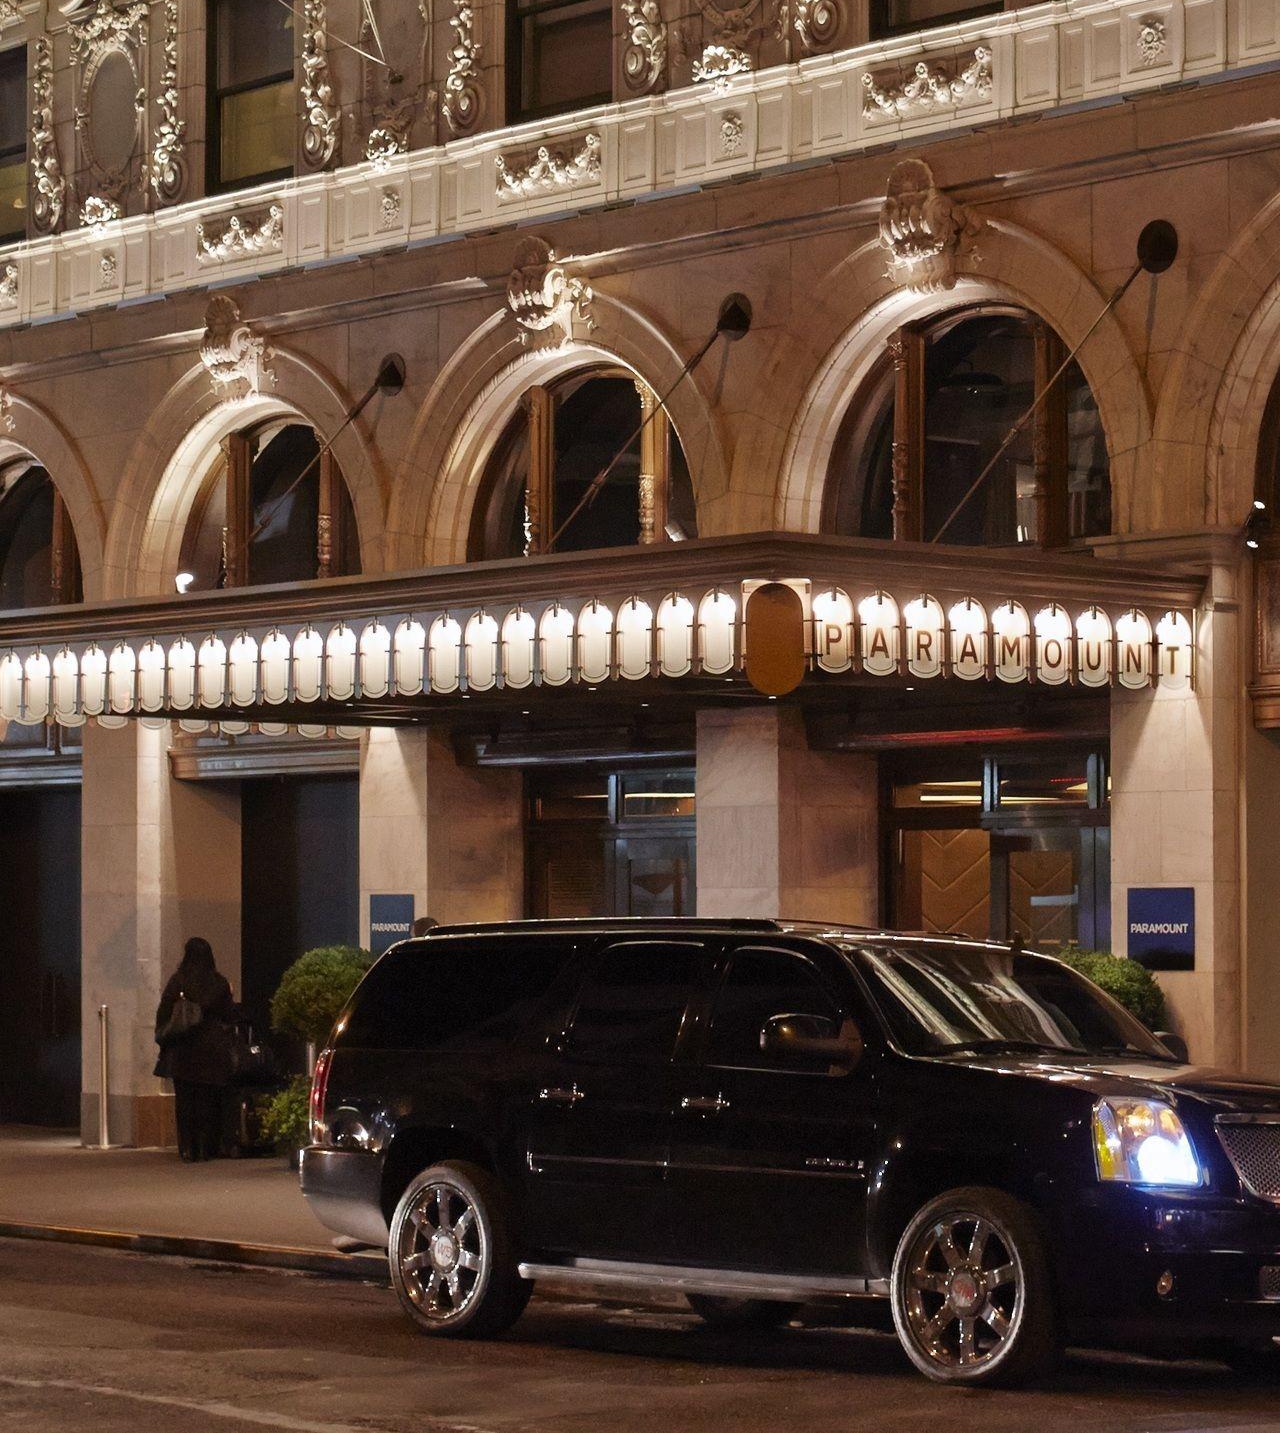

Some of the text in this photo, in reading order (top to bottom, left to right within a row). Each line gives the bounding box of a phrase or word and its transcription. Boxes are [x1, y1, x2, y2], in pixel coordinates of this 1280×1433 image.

[825, 623, 1181, 675] PARAMOUNT
[371, 922, 410, 932] PARAMOUNT
[1130, 923, 1189, 934] PARAMOUNT
